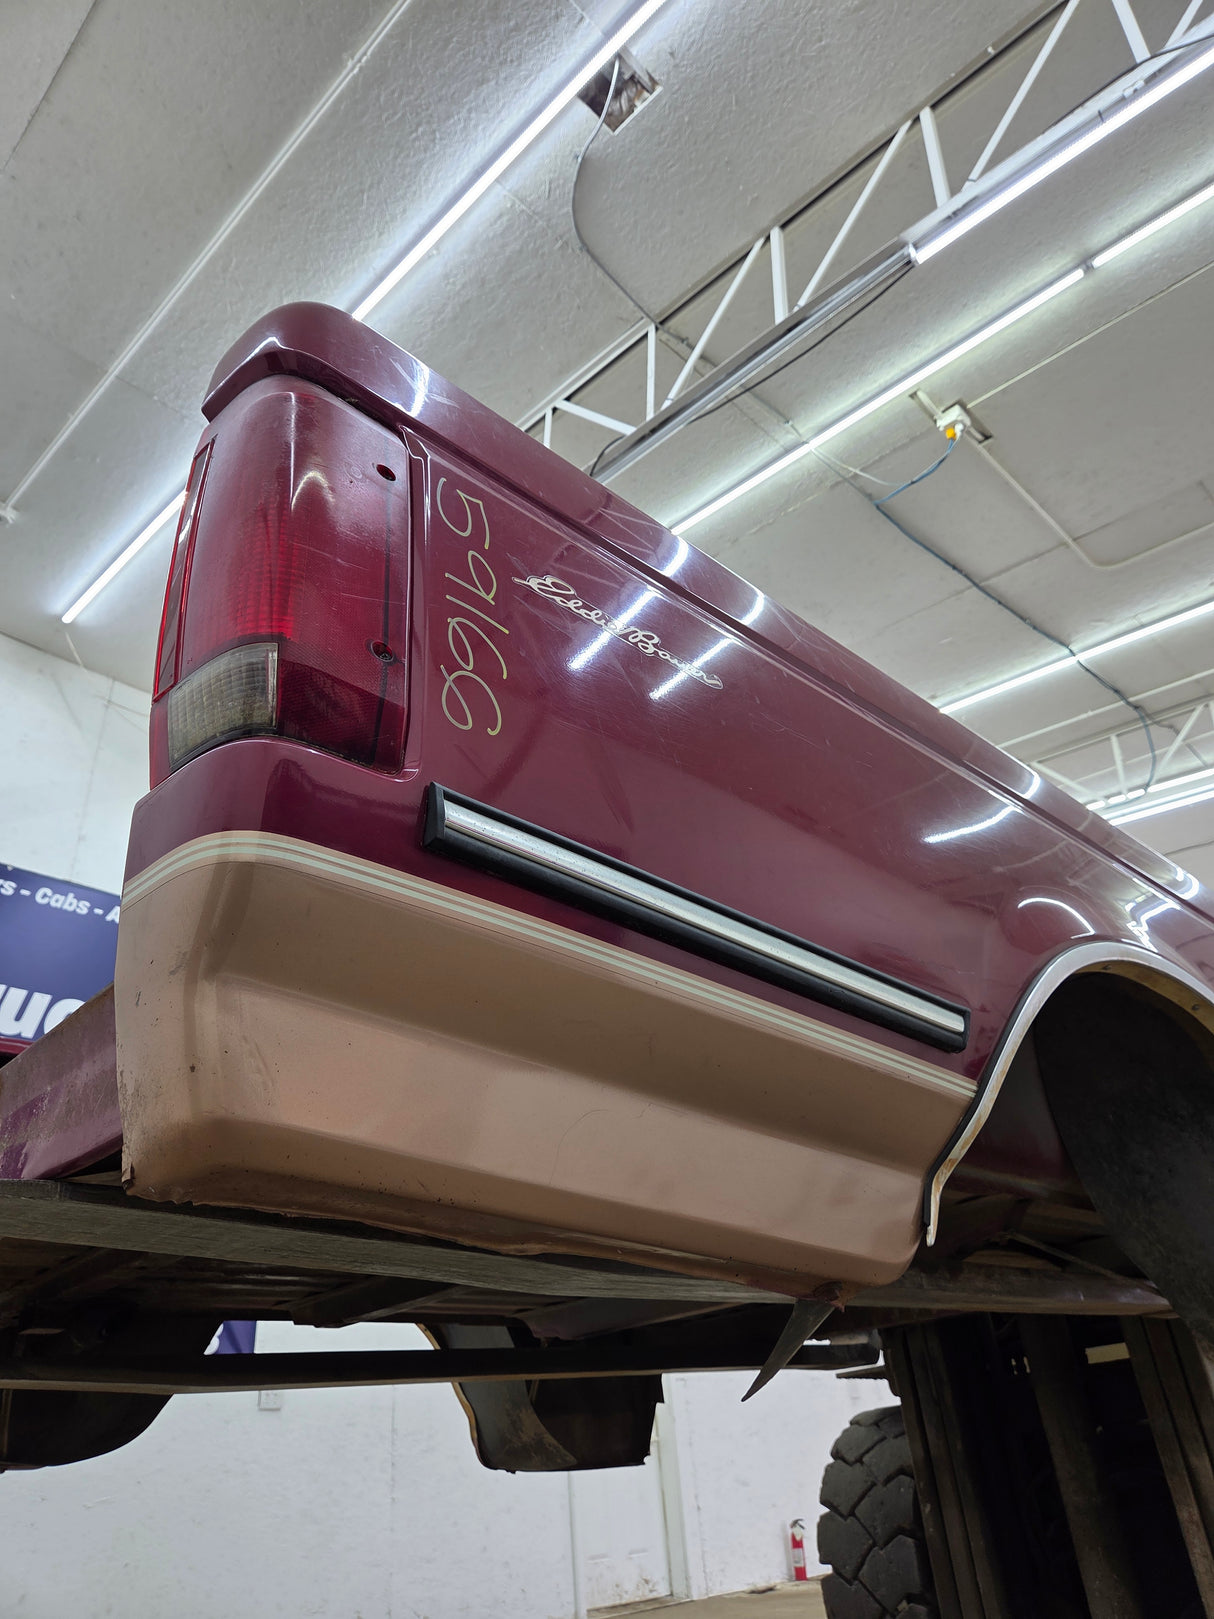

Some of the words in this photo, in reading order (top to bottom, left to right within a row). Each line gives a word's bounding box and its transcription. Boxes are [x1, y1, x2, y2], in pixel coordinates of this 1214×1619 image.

[437, 477, 510, 736] 59166
[511, 574, 620, 633] Eddie
[617, 625, 723, 689] Bauer
[35, 887, 91, 915] Cabs
